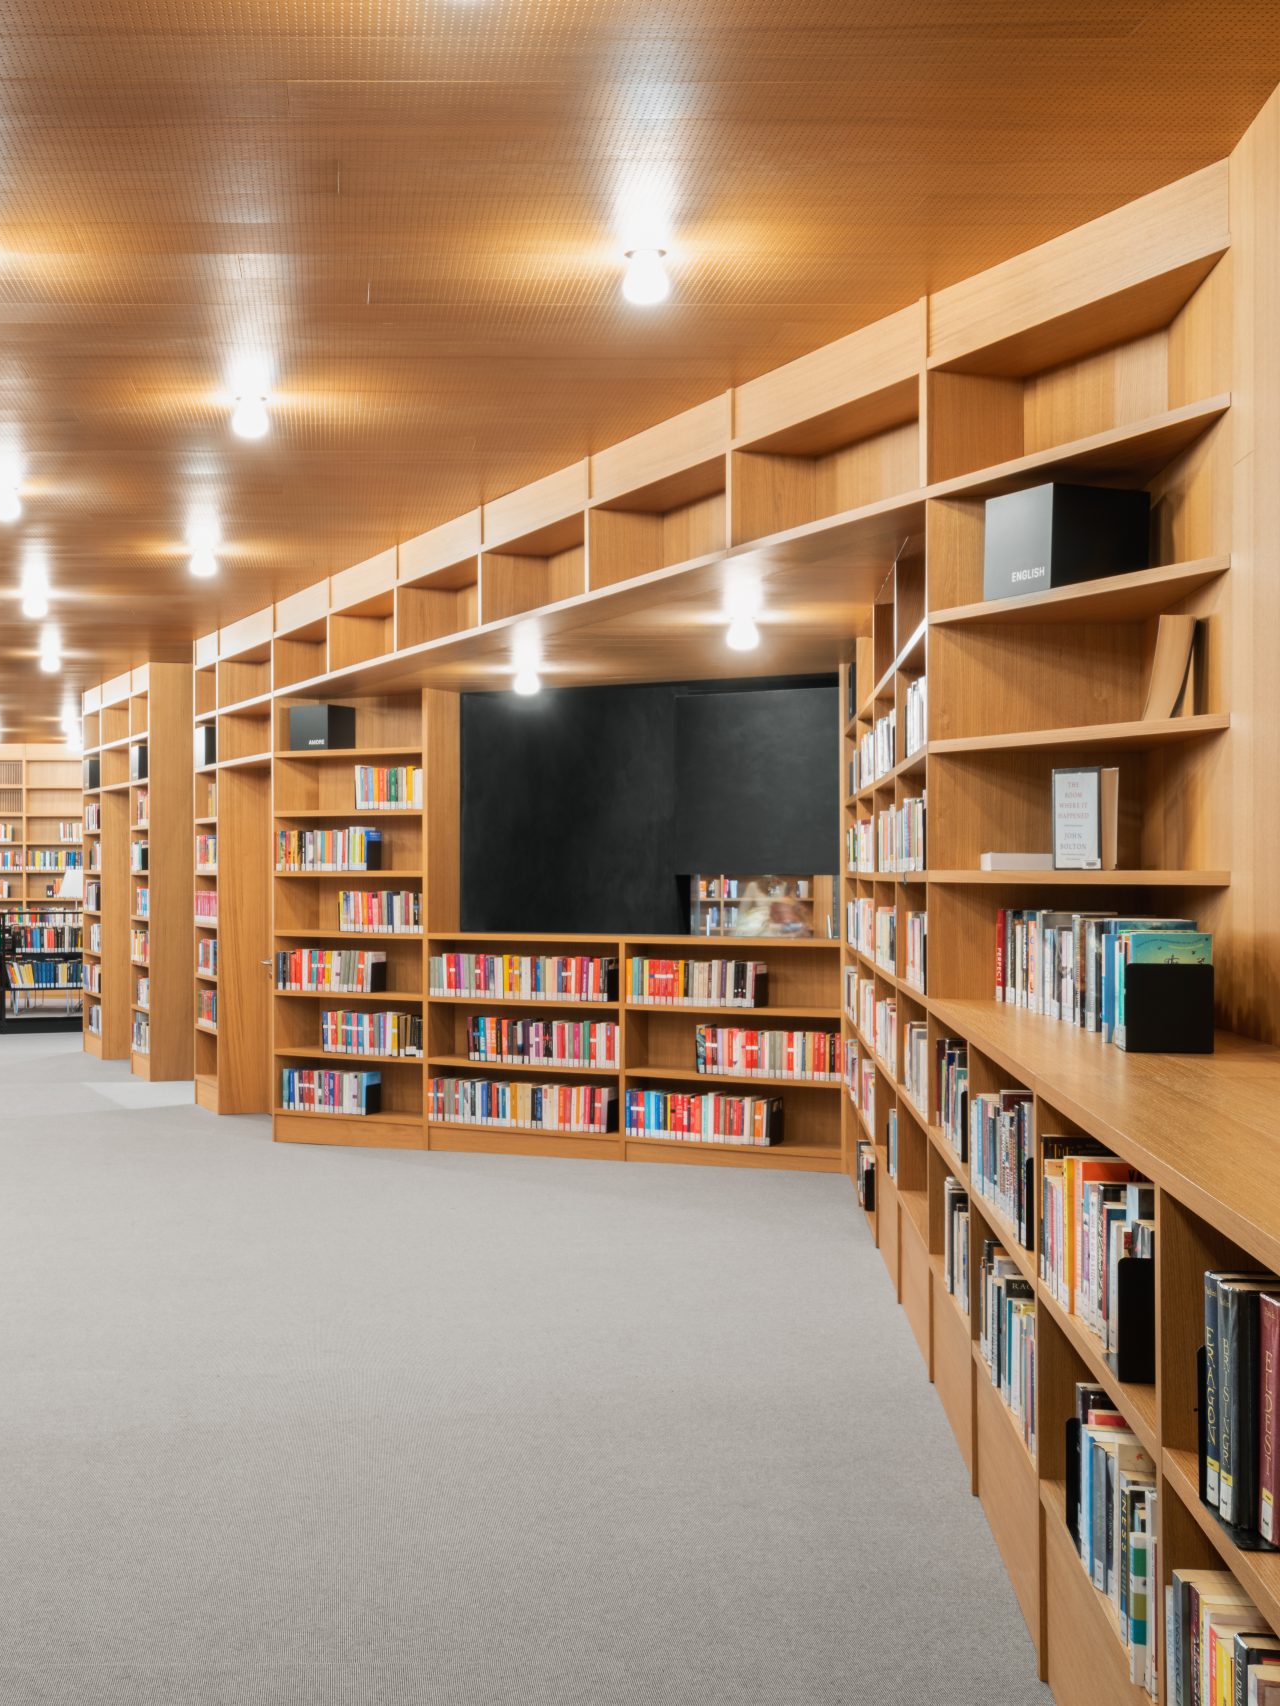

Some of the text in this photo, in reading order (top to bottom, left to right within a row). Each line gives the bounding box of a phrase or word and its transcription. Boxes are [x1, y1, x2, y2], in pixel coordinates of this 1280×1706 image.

[1011, 566, 1045, 583] ENGLISH
[1064, 832, 1083, 840] JOHN
[1206, 1327, 1216, 1446] ERAGON
[1222, 1338, 1231, 1466] BRISINGR
[1264, 1351, 1273, 1476] ELDEST
